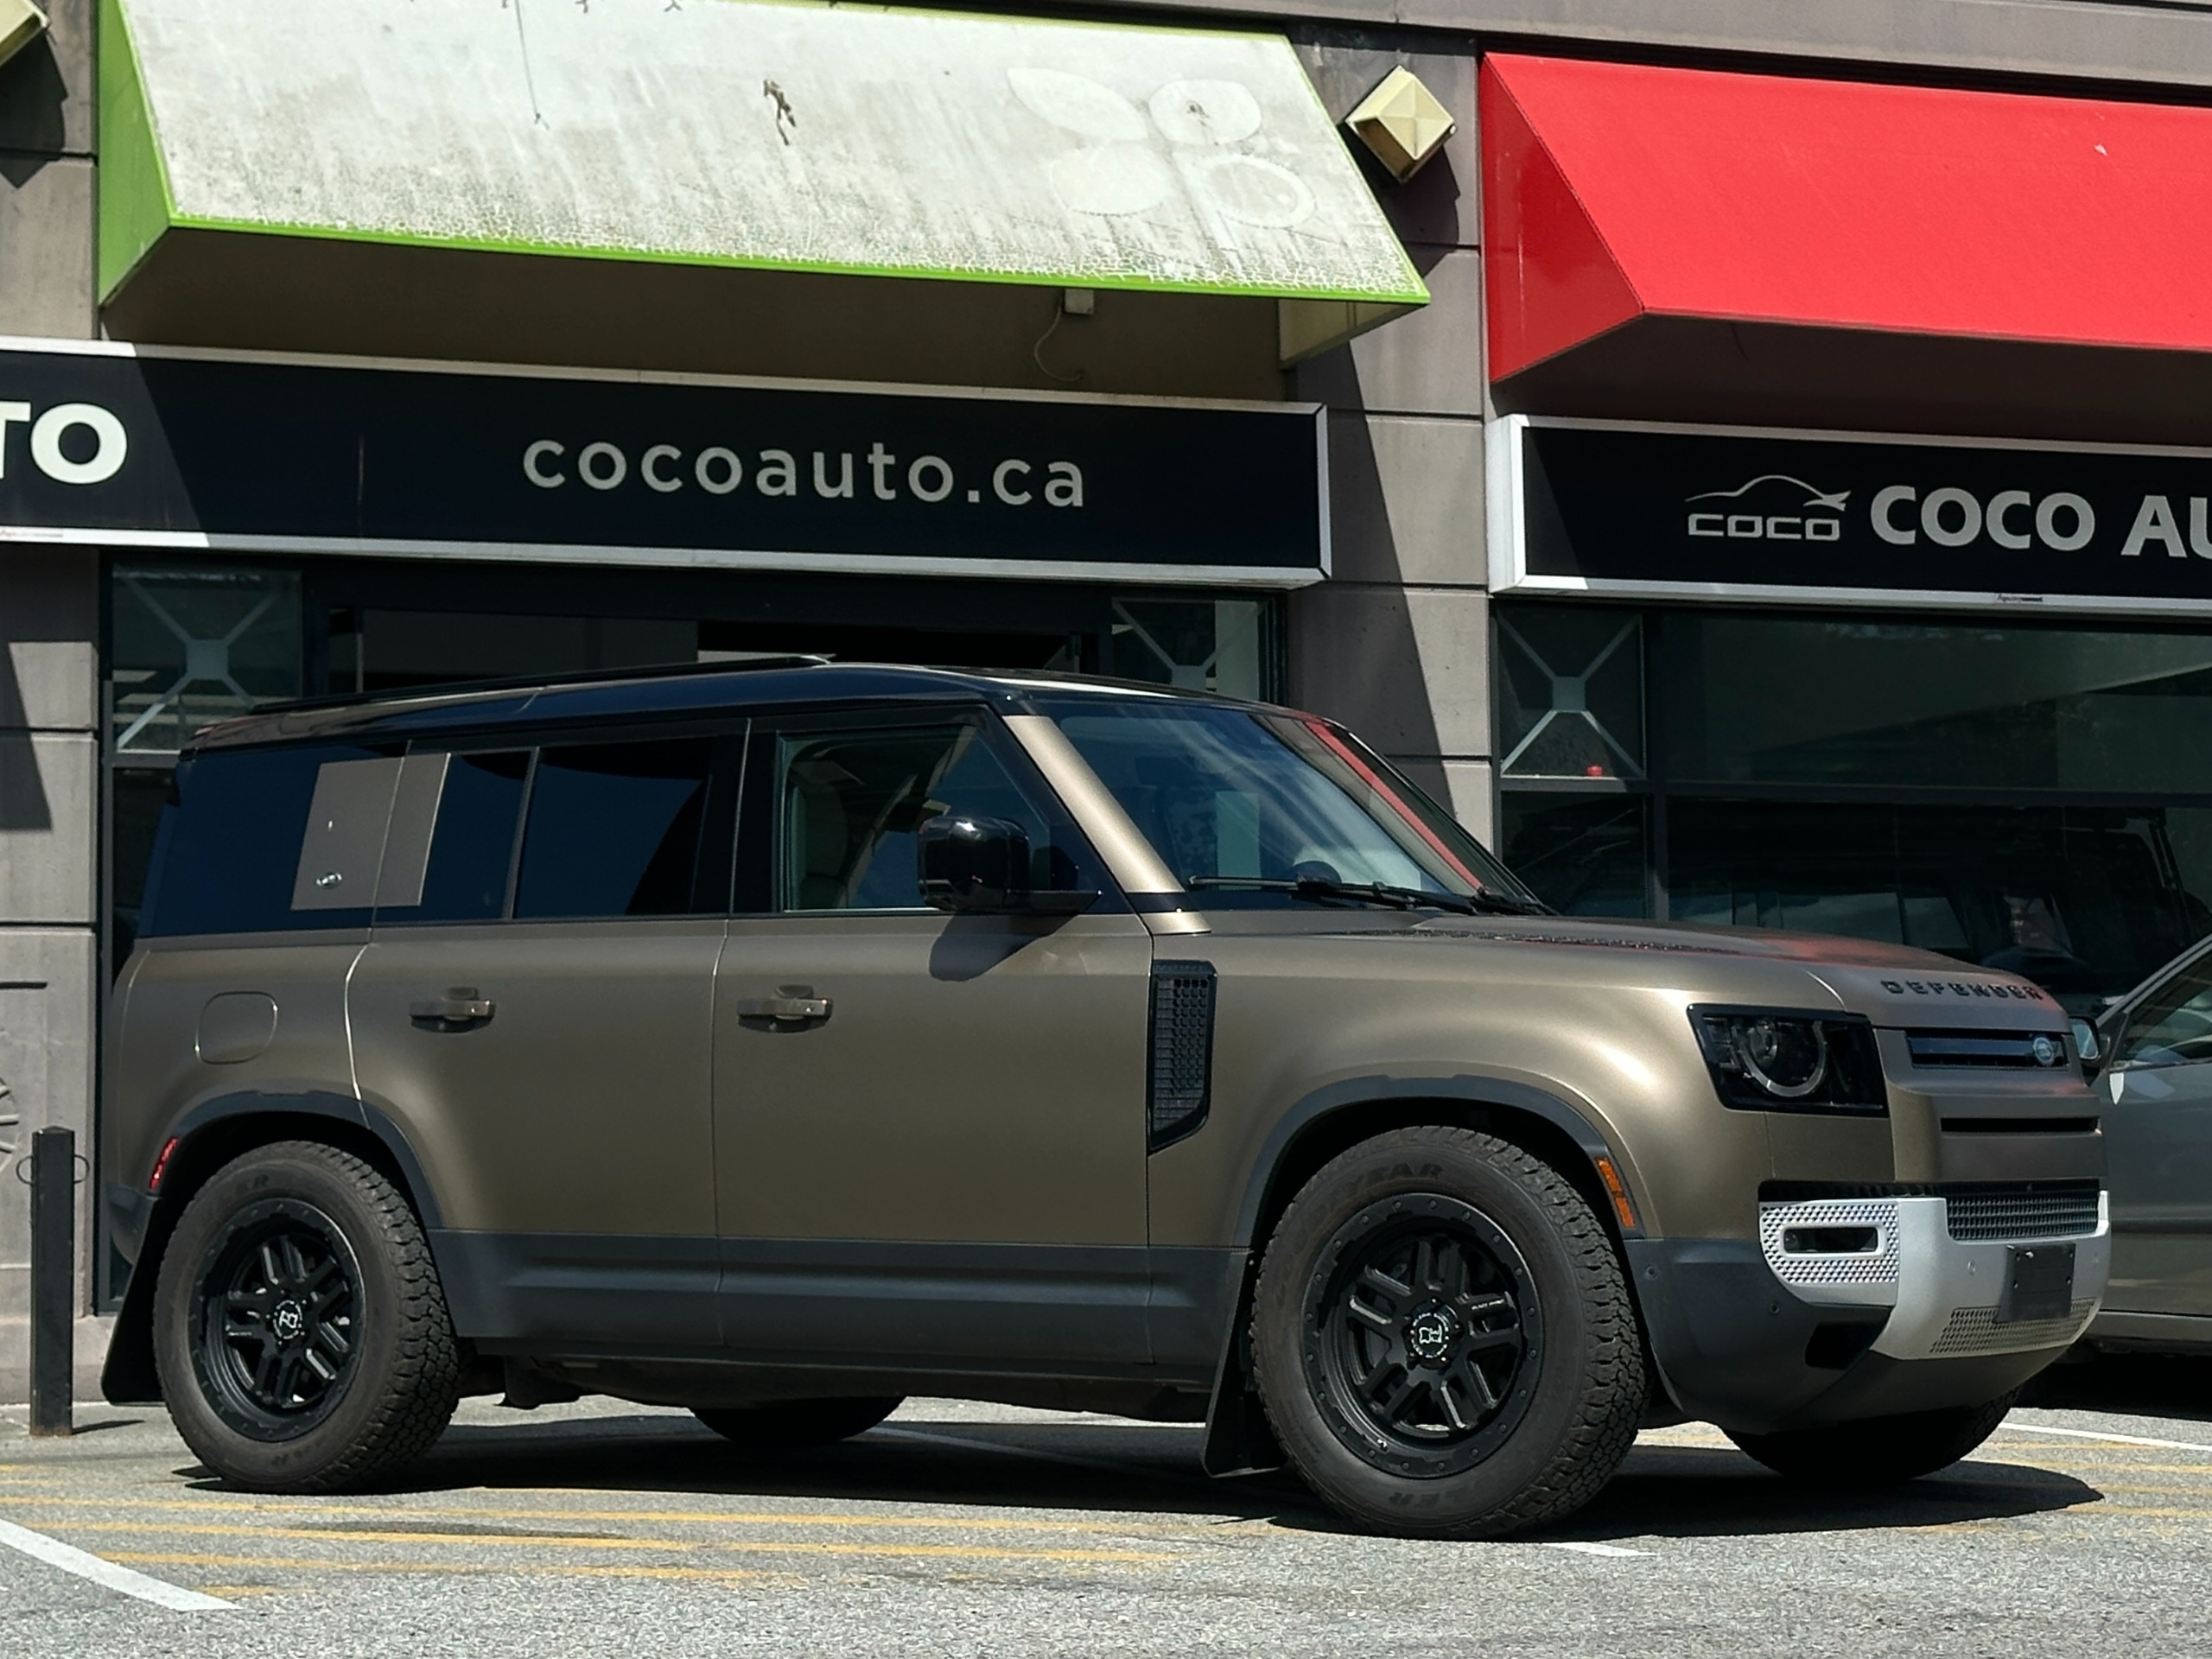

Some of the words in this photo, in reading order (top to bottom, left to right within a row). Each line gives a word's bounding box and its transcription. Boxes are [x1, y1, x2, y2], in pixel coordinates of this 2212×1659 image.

[523, 439, 1084, 507] cocoauto.ca
[1688, 513, 1840, 541] COCO
[1870, 485, 2096, 551] COCO
[1880, 980, 2044, 1001] DEFENDER
